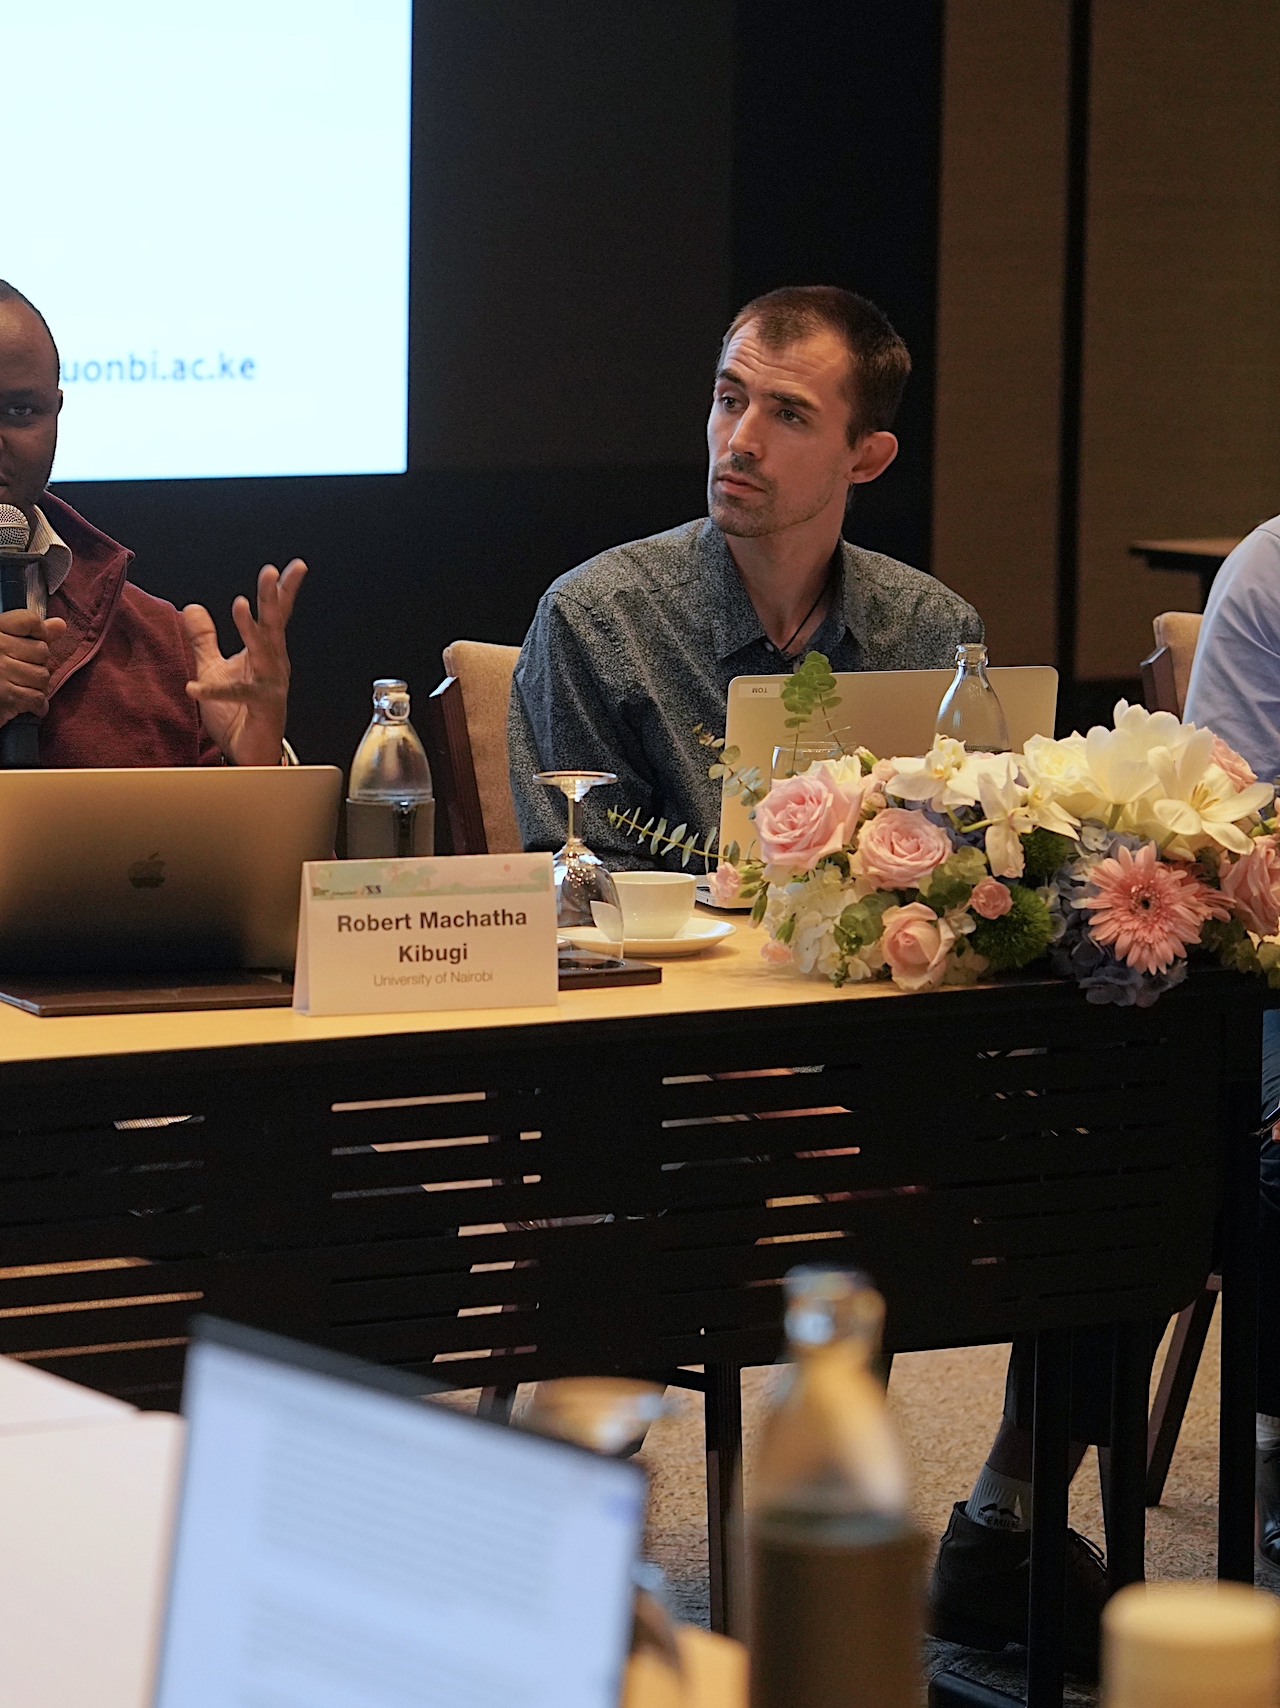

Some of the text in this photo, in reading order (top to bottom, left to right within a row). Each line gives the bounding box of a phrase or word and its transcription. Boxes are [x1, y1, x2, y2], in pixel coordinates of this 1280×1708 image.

[337, 908, 527, 933] Robert Machatha
[399, 942, 468, 965] Kibugi
[373, 970, 494, 988] University of Nairobi
